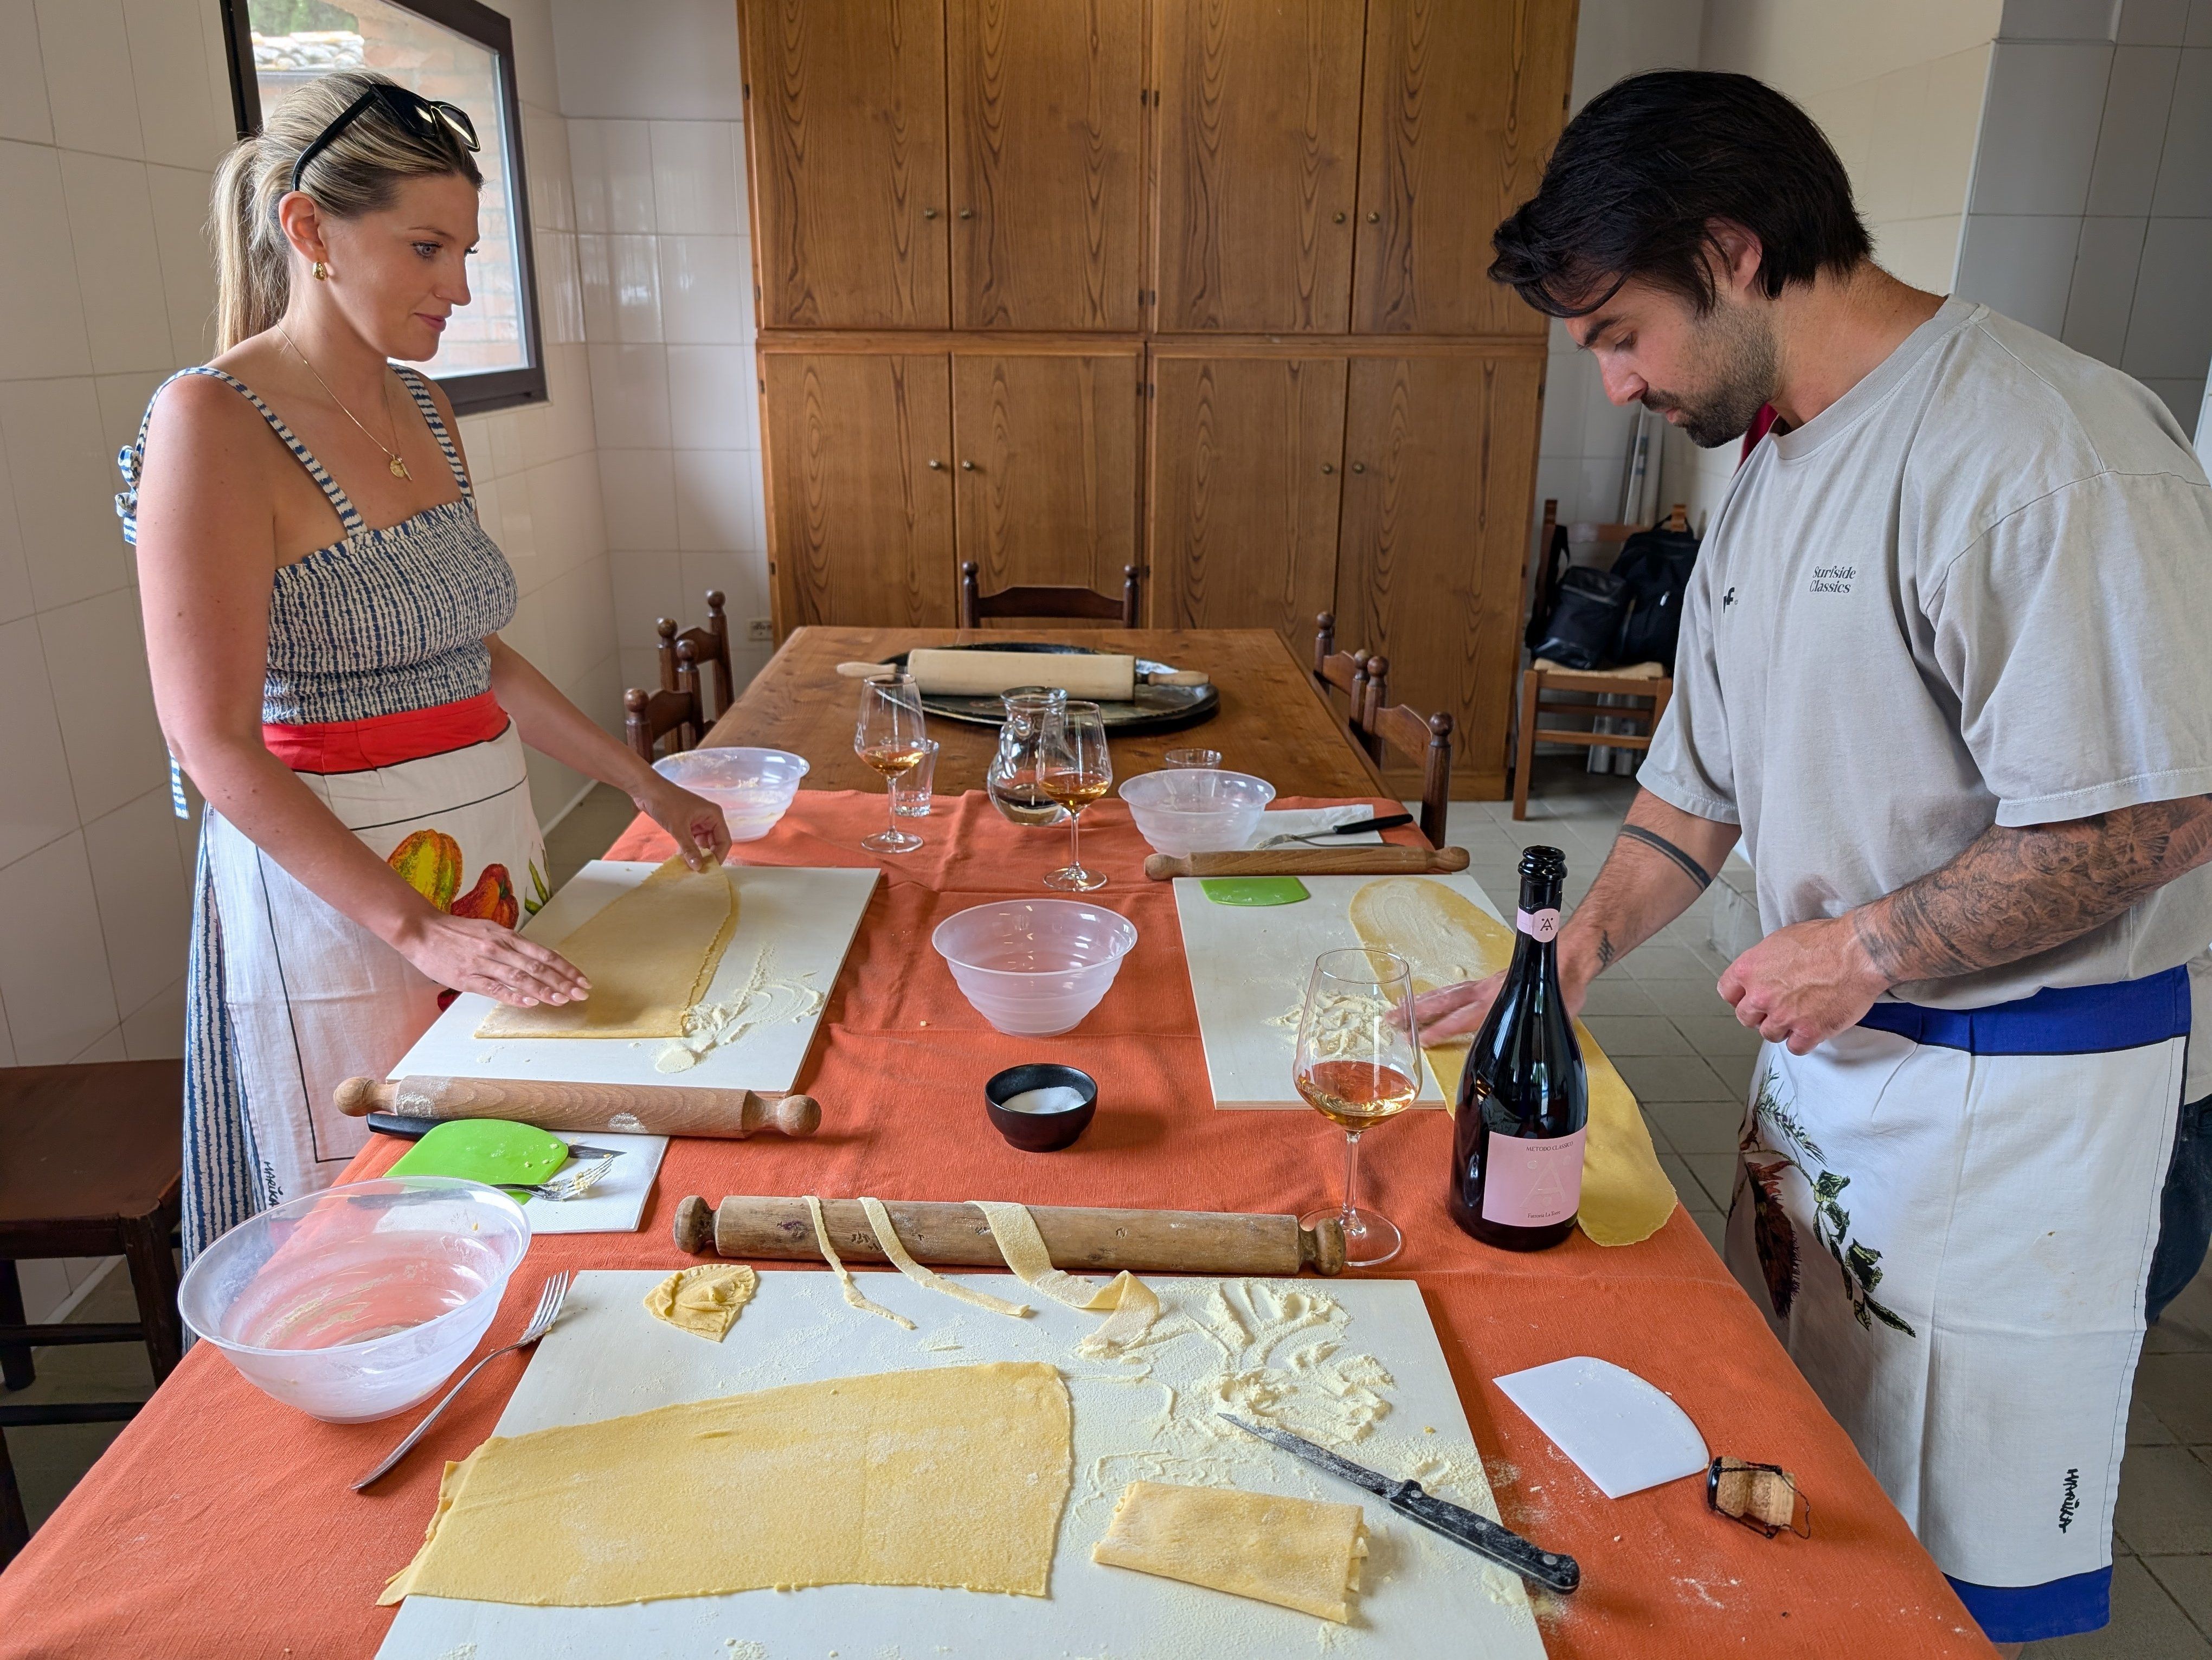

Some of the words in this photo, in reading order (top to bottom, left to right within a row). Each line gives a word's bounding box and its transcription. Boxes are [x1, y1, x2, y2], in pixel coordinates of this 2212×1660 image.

[1812, 565, 1856, 579] Surfside
[1809, 580, 1851, 593] Classics
[1552, 1141, 1573, 1150] CLASSICO
